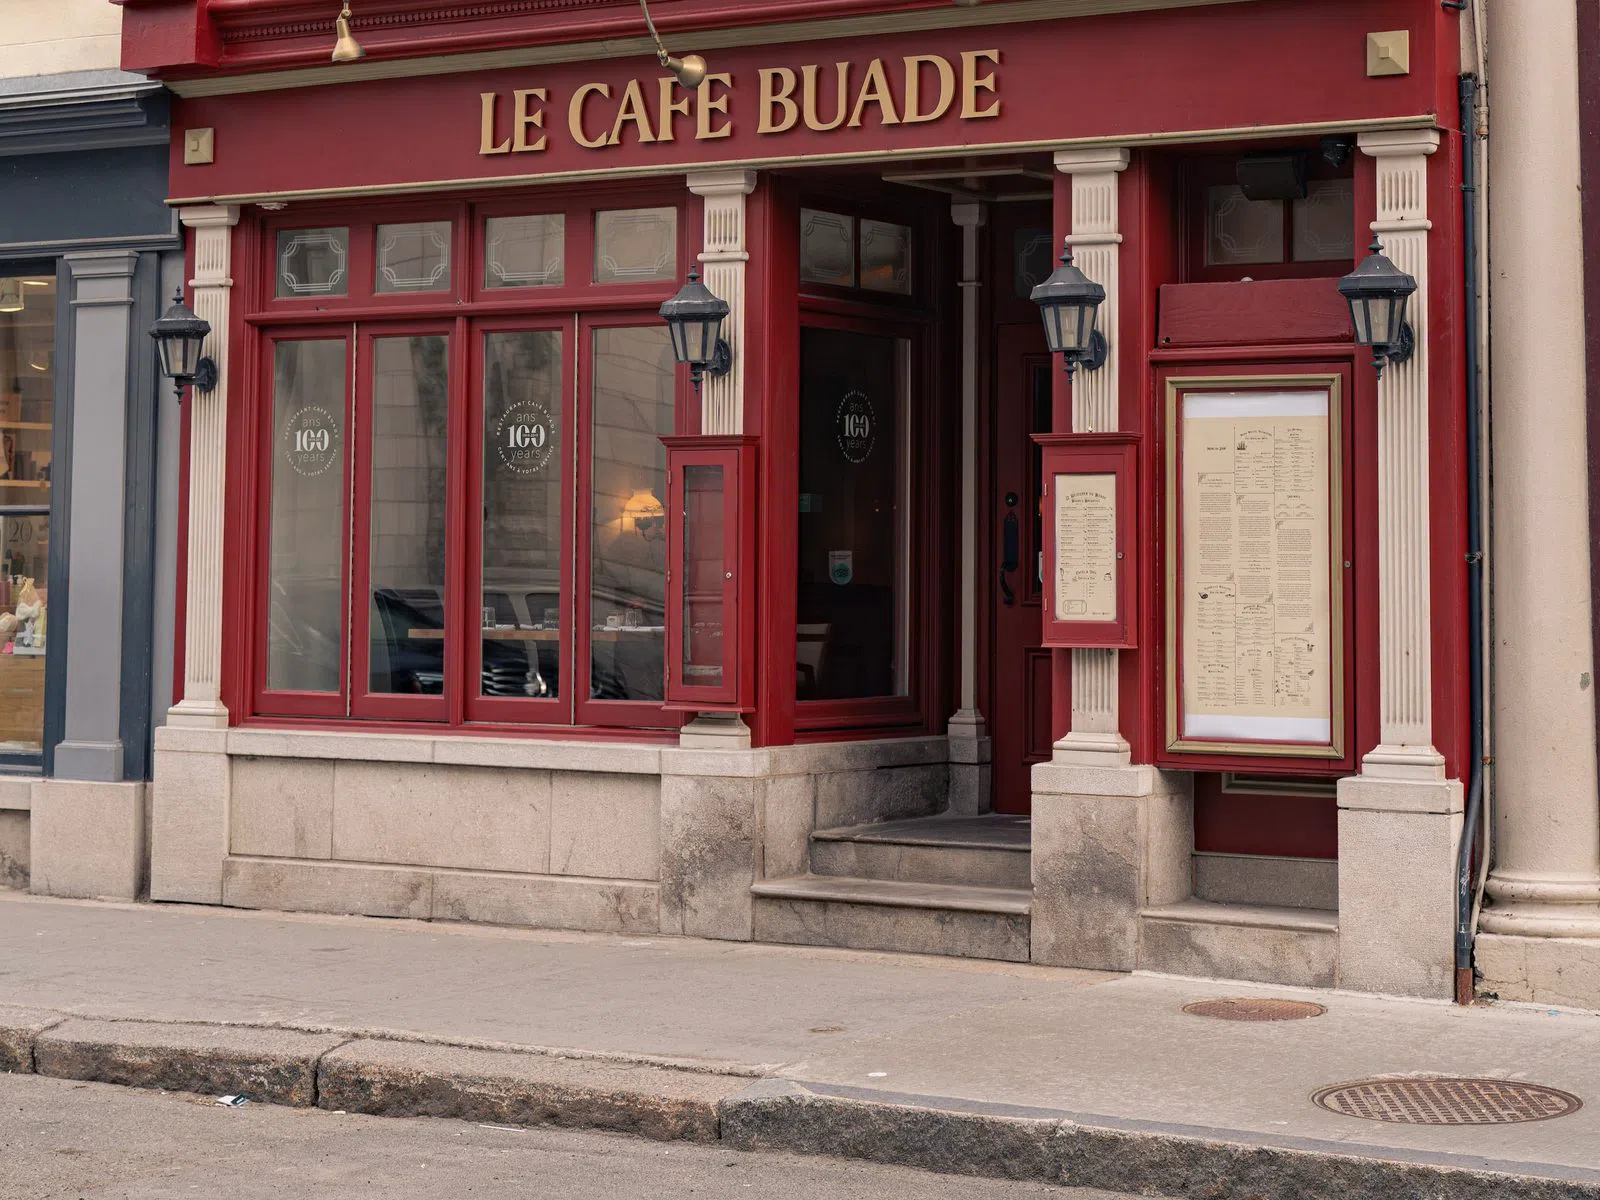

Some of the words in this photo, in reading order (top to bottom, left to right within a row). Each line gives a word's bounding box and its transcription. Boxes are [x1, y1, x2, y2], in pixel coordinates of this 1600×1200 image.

[479, 87, 548, 155] LE
[756, 48, 1001, 135] BUADE
[302, 419, 321, 427] ans
[516, 413, 536, 422] ans
[843, 413, 870, 438] 100
[294, 428, 330, 452] 100
[506, 424, 546, 448] 100
[297, 452, 325, 466] years
[510, 449, 541, 463] years
